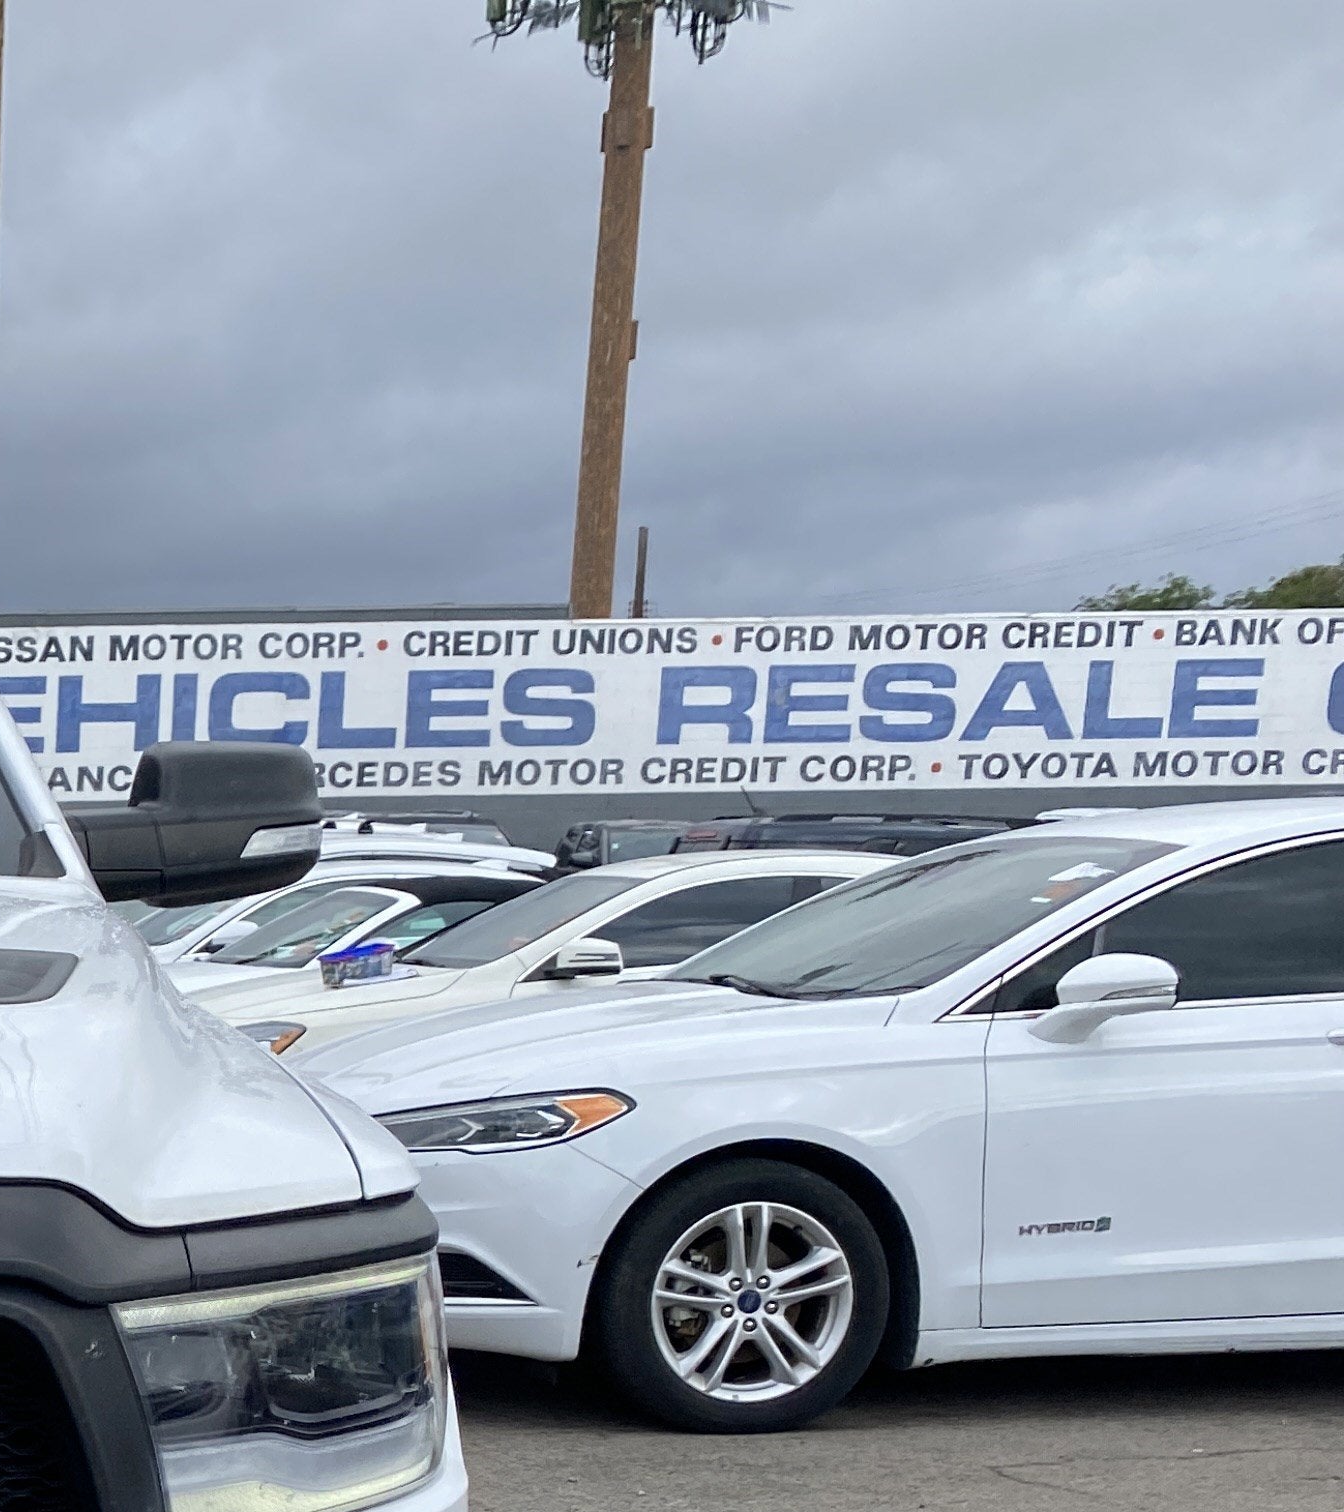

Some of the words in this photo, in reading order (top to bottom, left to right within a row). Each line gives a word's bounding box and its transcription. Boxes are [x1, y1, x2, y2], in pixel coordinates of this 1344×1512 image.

[109, 633, 243, 662] MOTOR
[258, 631, 365, 660] CORP.
[403, 629, 539, 658] CREDIT
[552, 627, 698, 656] UNIONS
[733, 625, 834, 654] FORD
[847, 623, 988, 651] MOTOR
[1001, 620, 1144, 650] CREDIT
[1174, 618, 1284, 647] BANK
[1297, 617, 1344, 645] OF
[655, 657, 1266, 746] RESALE
[477, 758, 625, 787] MOTOR
[640, 756, 787, 784] CREDIT
[799, 754, 916, 783] CORP.
[957, 752, 1116, 780] TOYOTA
[1132, 749, 1285, 778] MOTOR
[1018, 1219, 1095, 1236] HYBRID
